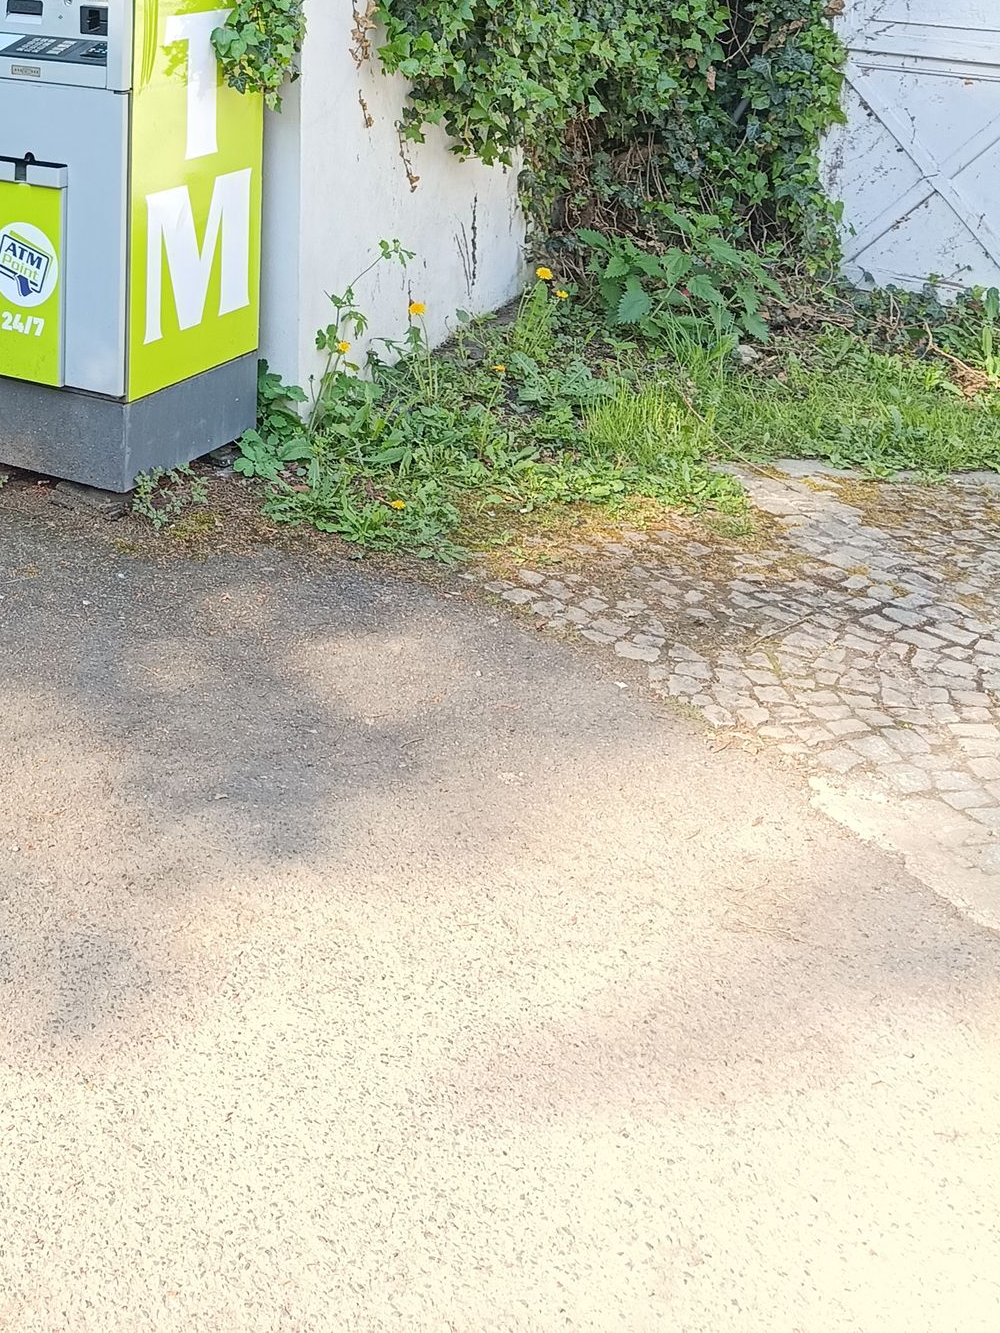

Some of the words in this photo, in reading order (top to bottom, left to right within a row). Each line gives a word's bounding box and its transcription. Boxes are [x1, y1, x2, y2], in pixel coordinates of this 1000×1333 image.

[2, 253, 39, 281] Point
[5, 242, 42, 269] ATM
[1, 311, 44, 336] 24/7
